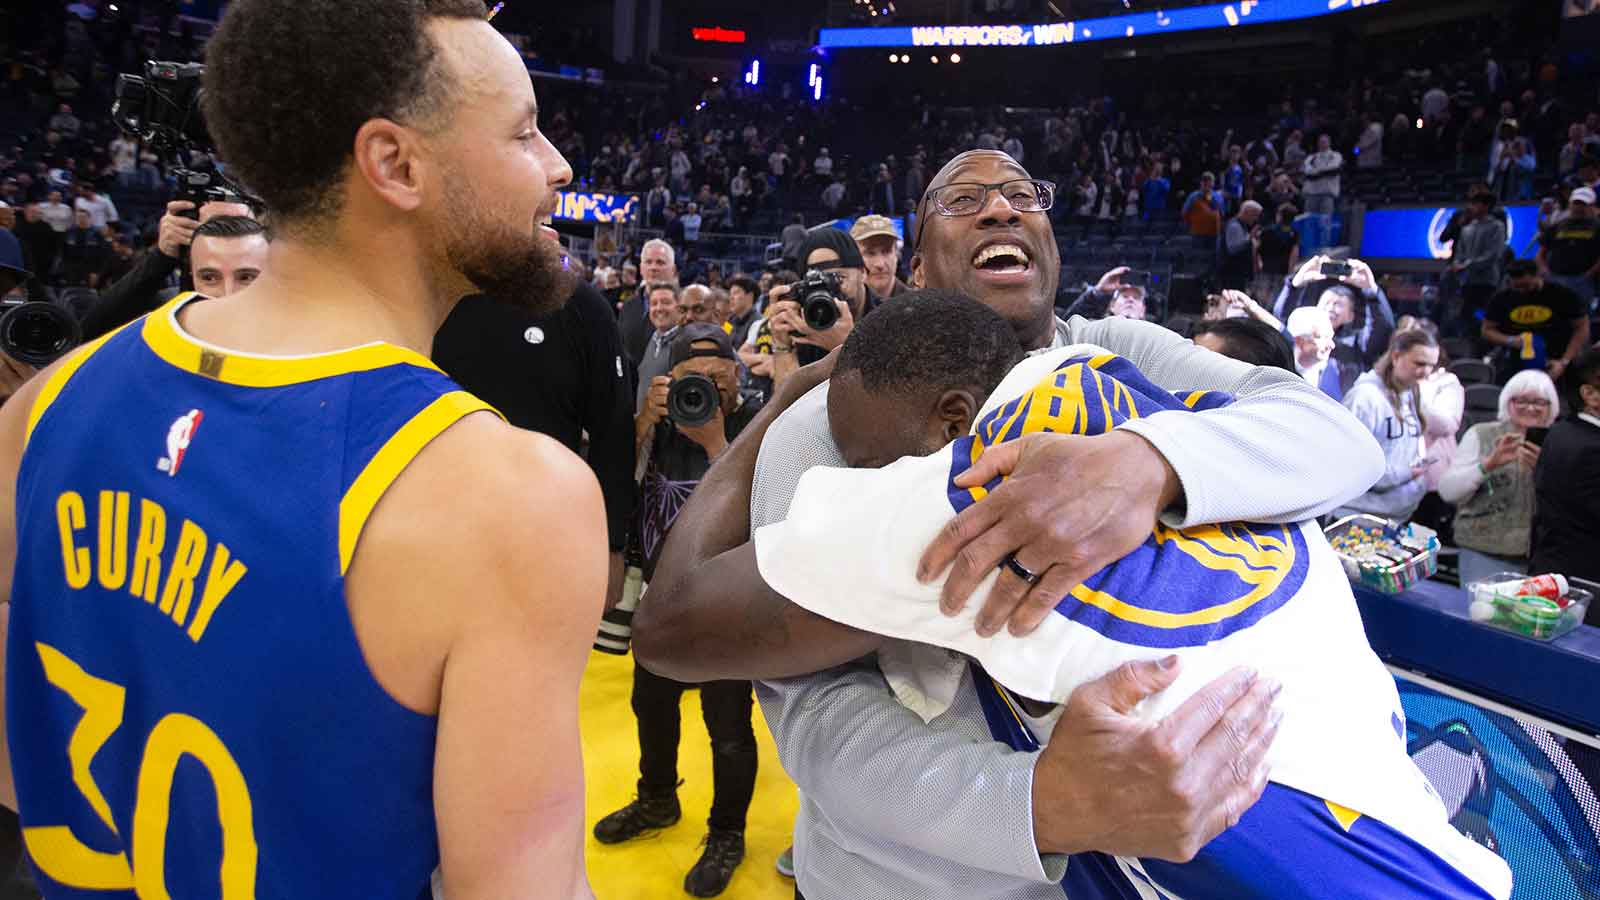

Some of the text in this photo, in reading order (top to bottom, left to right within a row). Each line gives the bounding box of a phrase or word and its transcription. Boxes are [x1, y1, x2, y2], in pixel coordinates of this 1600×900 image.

[911, 22, 1075, 46] WARRIORS WIN
[56, 490, 248, 643] CURRY
[22, 640, 258, 900] 30
